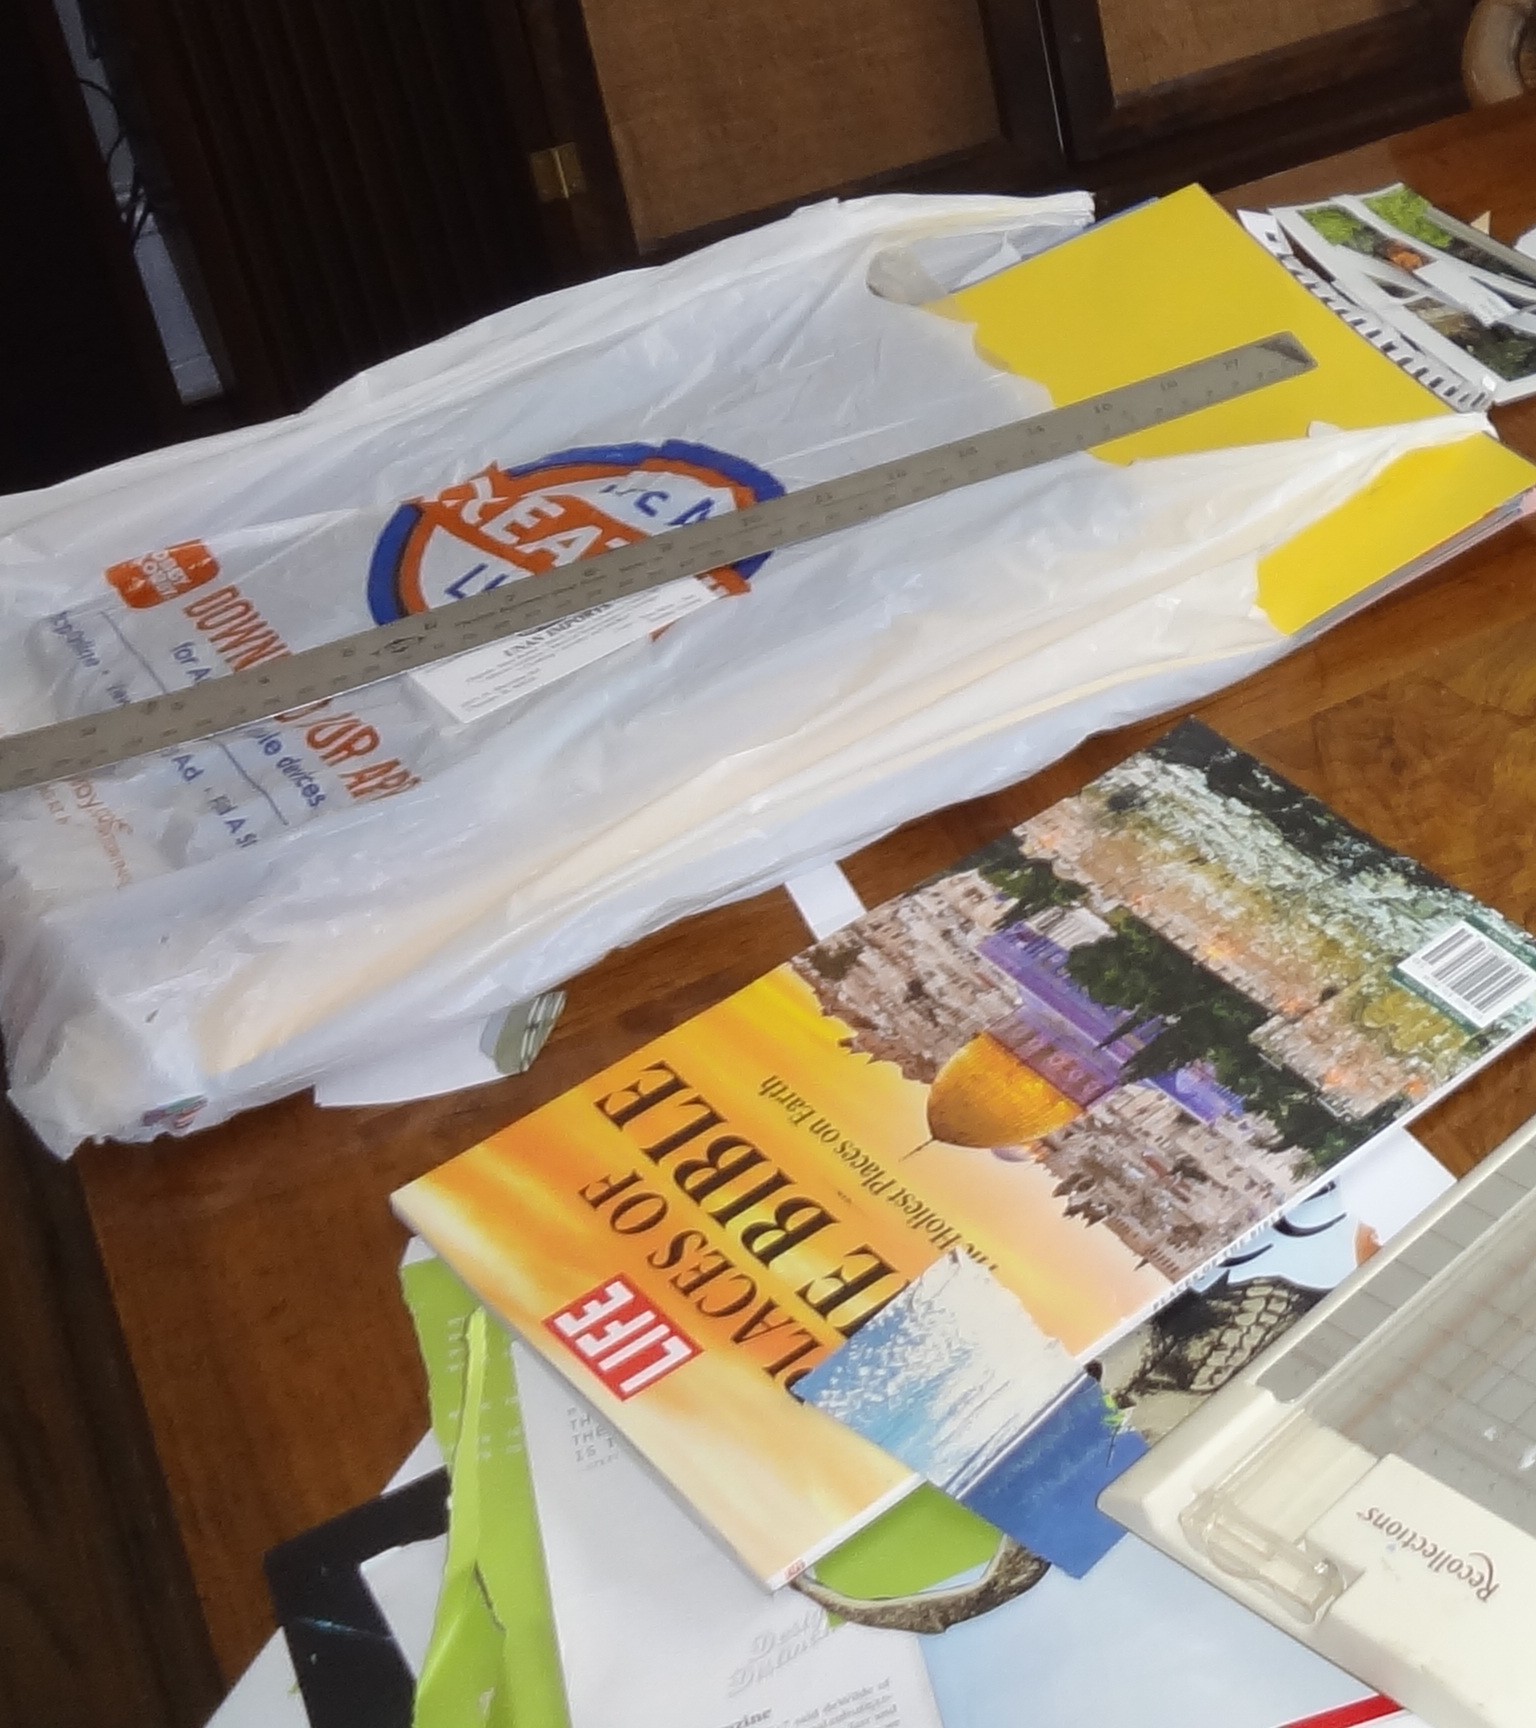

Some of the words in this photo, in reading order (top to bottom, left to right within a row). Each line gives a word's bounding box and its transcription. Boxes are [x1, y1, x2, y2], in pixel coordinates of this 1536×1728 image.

[171, 640, 199, 667] for
[170, 752, 204, 783] Ad
[758, 1074, 816, 1127] Earth
[809, 1117, 841, 1145] on
[593, 1060, 840, 1268] BIBLE
[833, 1139, 887, 1197] Places
[579, 1169, 669, 1235] OF
[887, 1178, 962, 1251] Holiest
[554, 1280, 693, 1394] LIFE
